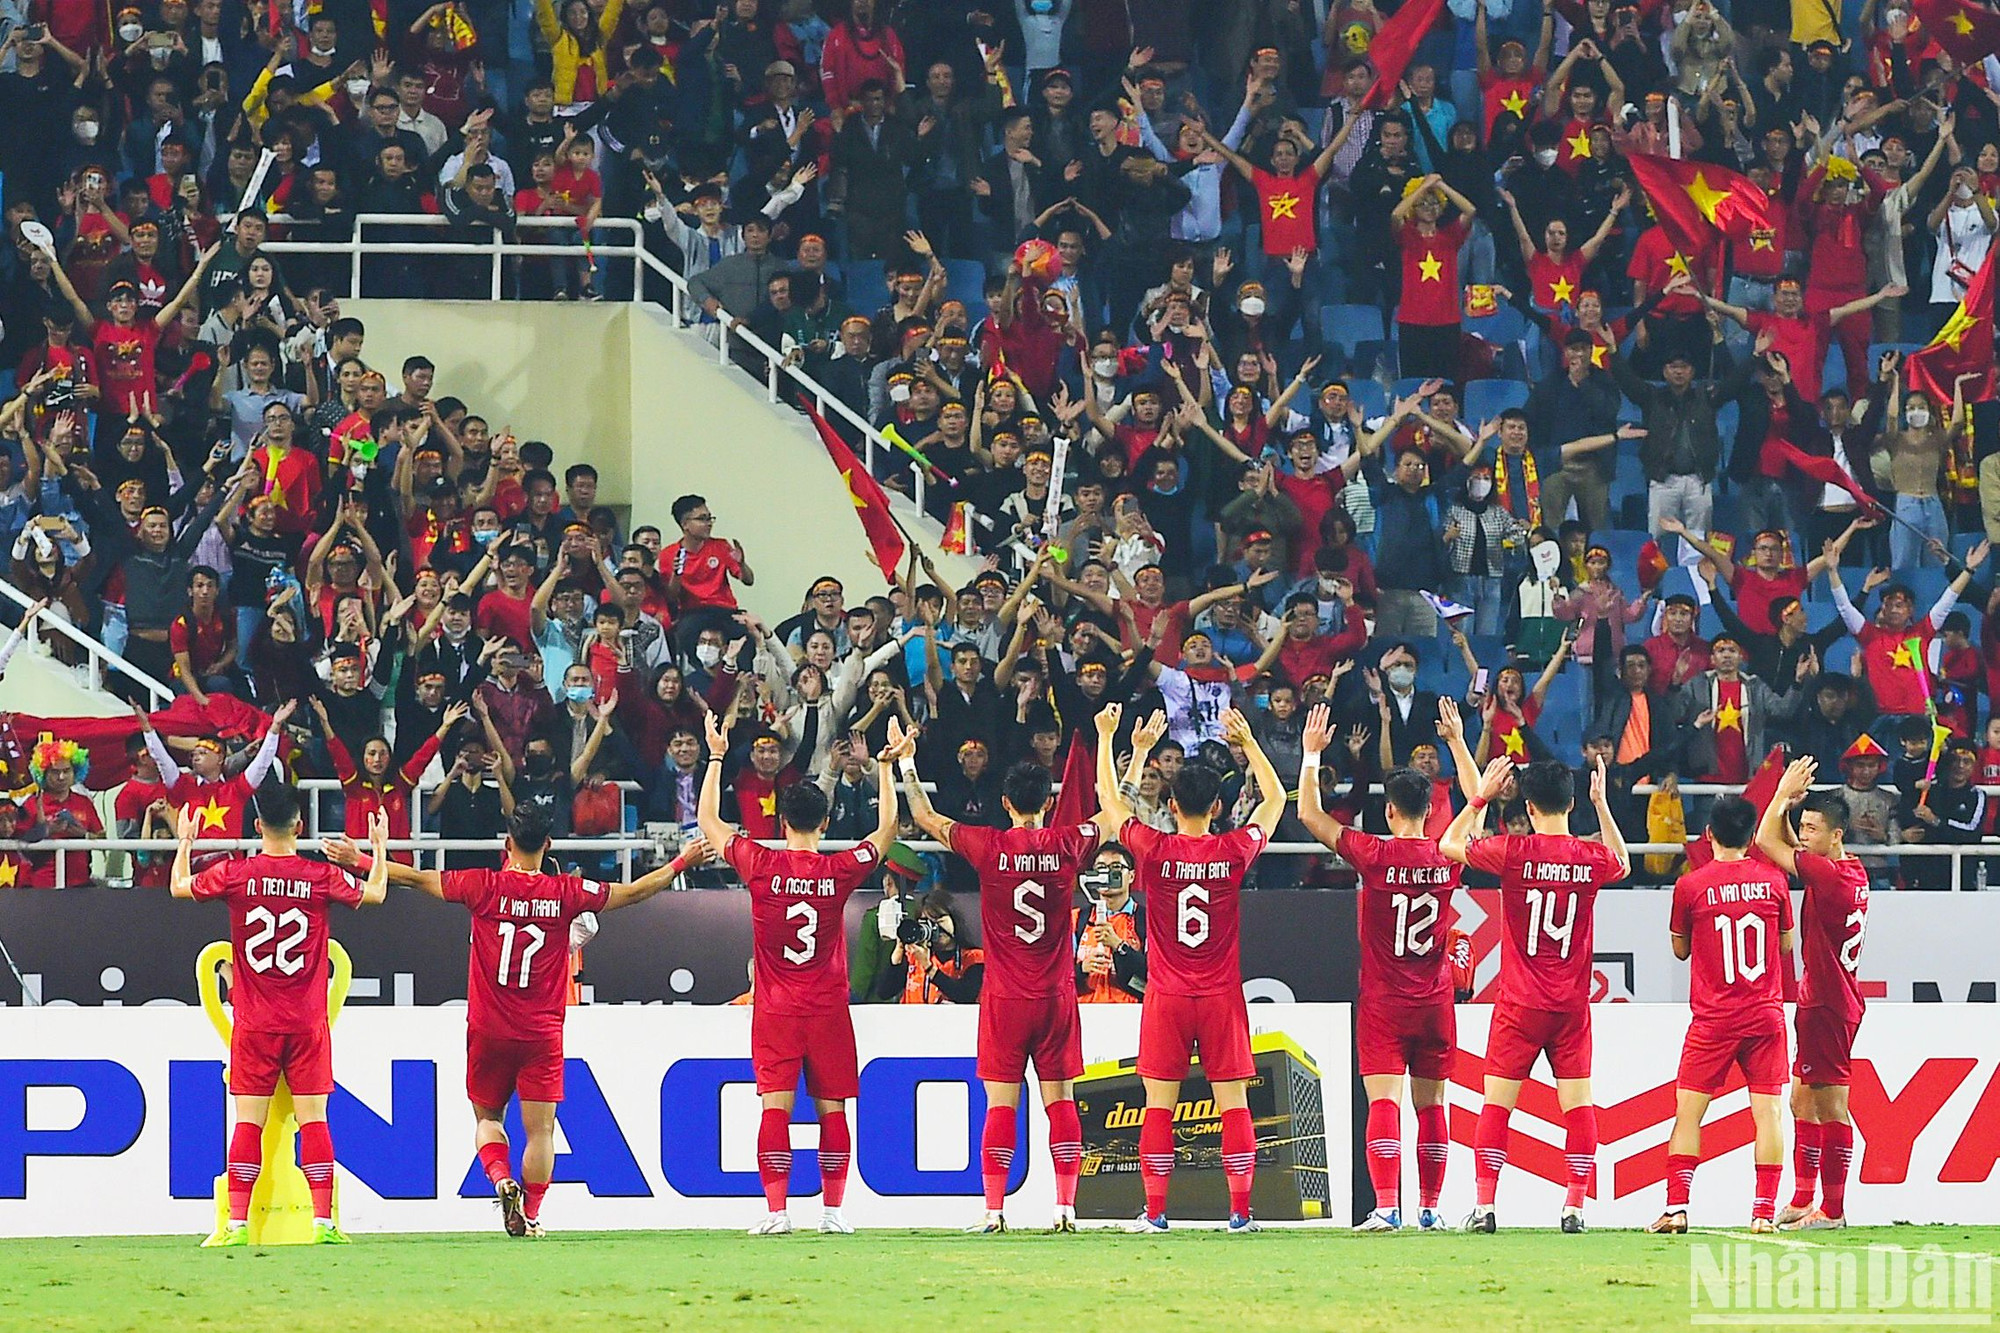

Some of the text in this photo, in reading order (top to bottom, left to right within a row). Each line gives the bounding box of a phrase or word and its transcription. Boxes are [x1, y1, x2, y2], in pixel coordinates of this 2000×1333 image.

[261, 877, 285, 896] TIEN
[286, 879, 312, 899] LINH
[772, 875, 835, 897] Q. NGOC HAI
[999, 853, 1060, 872] D. VAN HAU
[1175, 861, 1207, 879] THANH
[1208, 861, 1231, 880] BINH
[1386, 866, 1451, 884] B. H. VIET ANH
[1536, 862, 1571, 880] HOANG
[1572, 864, 1594, 882] DUC
[1719, 883, 1740, 903] VAN
[1740, 882, 1772, 904] QUYET
[500, 895, 561, 918] V. VAN THANH
[783, 900, 818, 966] 3
[1013, 879, 1045, 944] 5
[1177, 884, 1210, 949] 6
[1391, 892, 1439, 957] 12
[1525, 888, 1578, 959] 14
[244, 905, 309, 976] 22
[497, 921, 546, 988] 17
[1714, 912, 1766, 985] 10
[1841, 908, 1869, 973] 2
